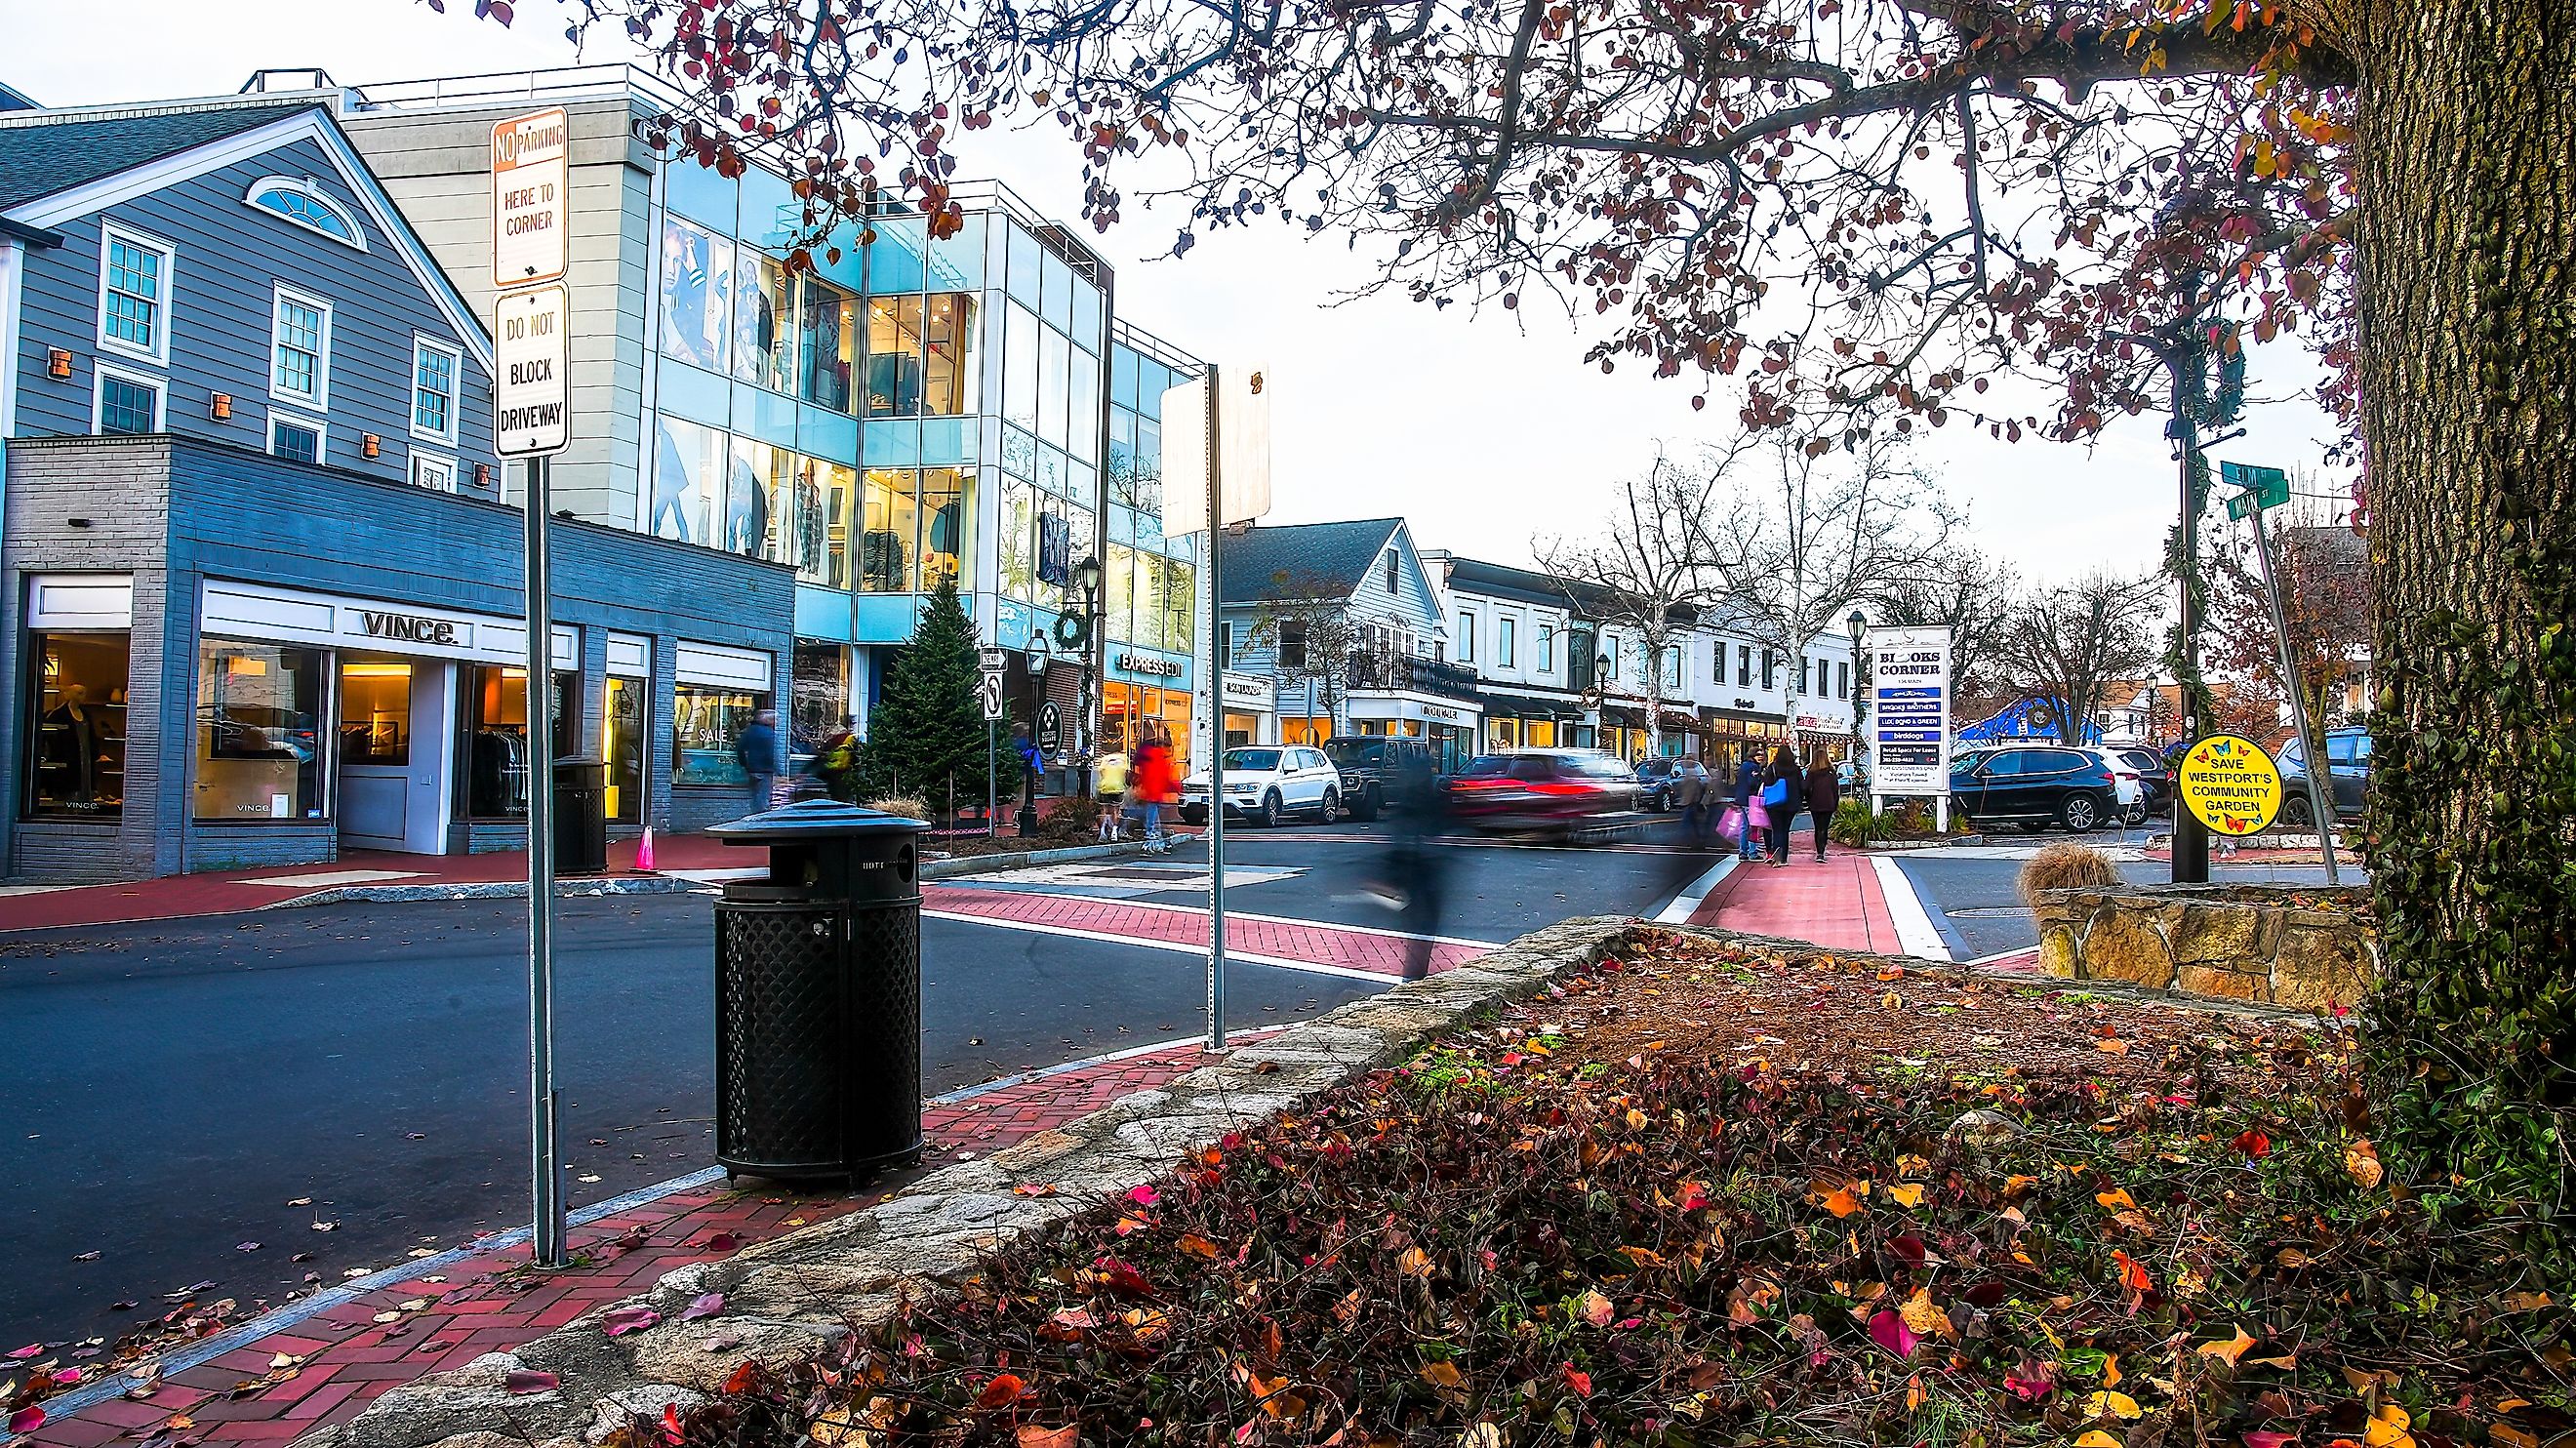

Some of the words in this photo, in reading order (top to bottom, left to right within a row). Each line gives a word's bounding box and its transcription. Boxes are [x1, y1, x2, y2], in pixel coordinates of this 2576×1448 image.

[496, 131, 516, 164] NO
[517, 124, 563, 154] PARKING
[504, 186, 536, 210] HERE
[540, 182, 553, 203] TO
[506, 210, 552, 236] CORNER
[506, 316, 524, 342] DO
[530, 311, 554, 338] NOT
[510, 357, 552, 386] BLOCK
[501, 401, 562, 432] DRIVEWAY
[2234, 492, 2259, 517] MAIN
[2262, 489, 2270, 499] ST
[1122, 654, 1164, 674] EXPRESS
[1165, 662, 1185, 678] EDIT
[1879, 664, 1940, 675] CORNER
[699, 728, 728, 742] SALE
[2211, 759, 2244, 769] SAVE
[2189, 771, 2273, 784] WESTPORT'S
[2192, 785, 2271, 798] COMMUNITY
[2205, 800, 2261, 812] GARDEN
